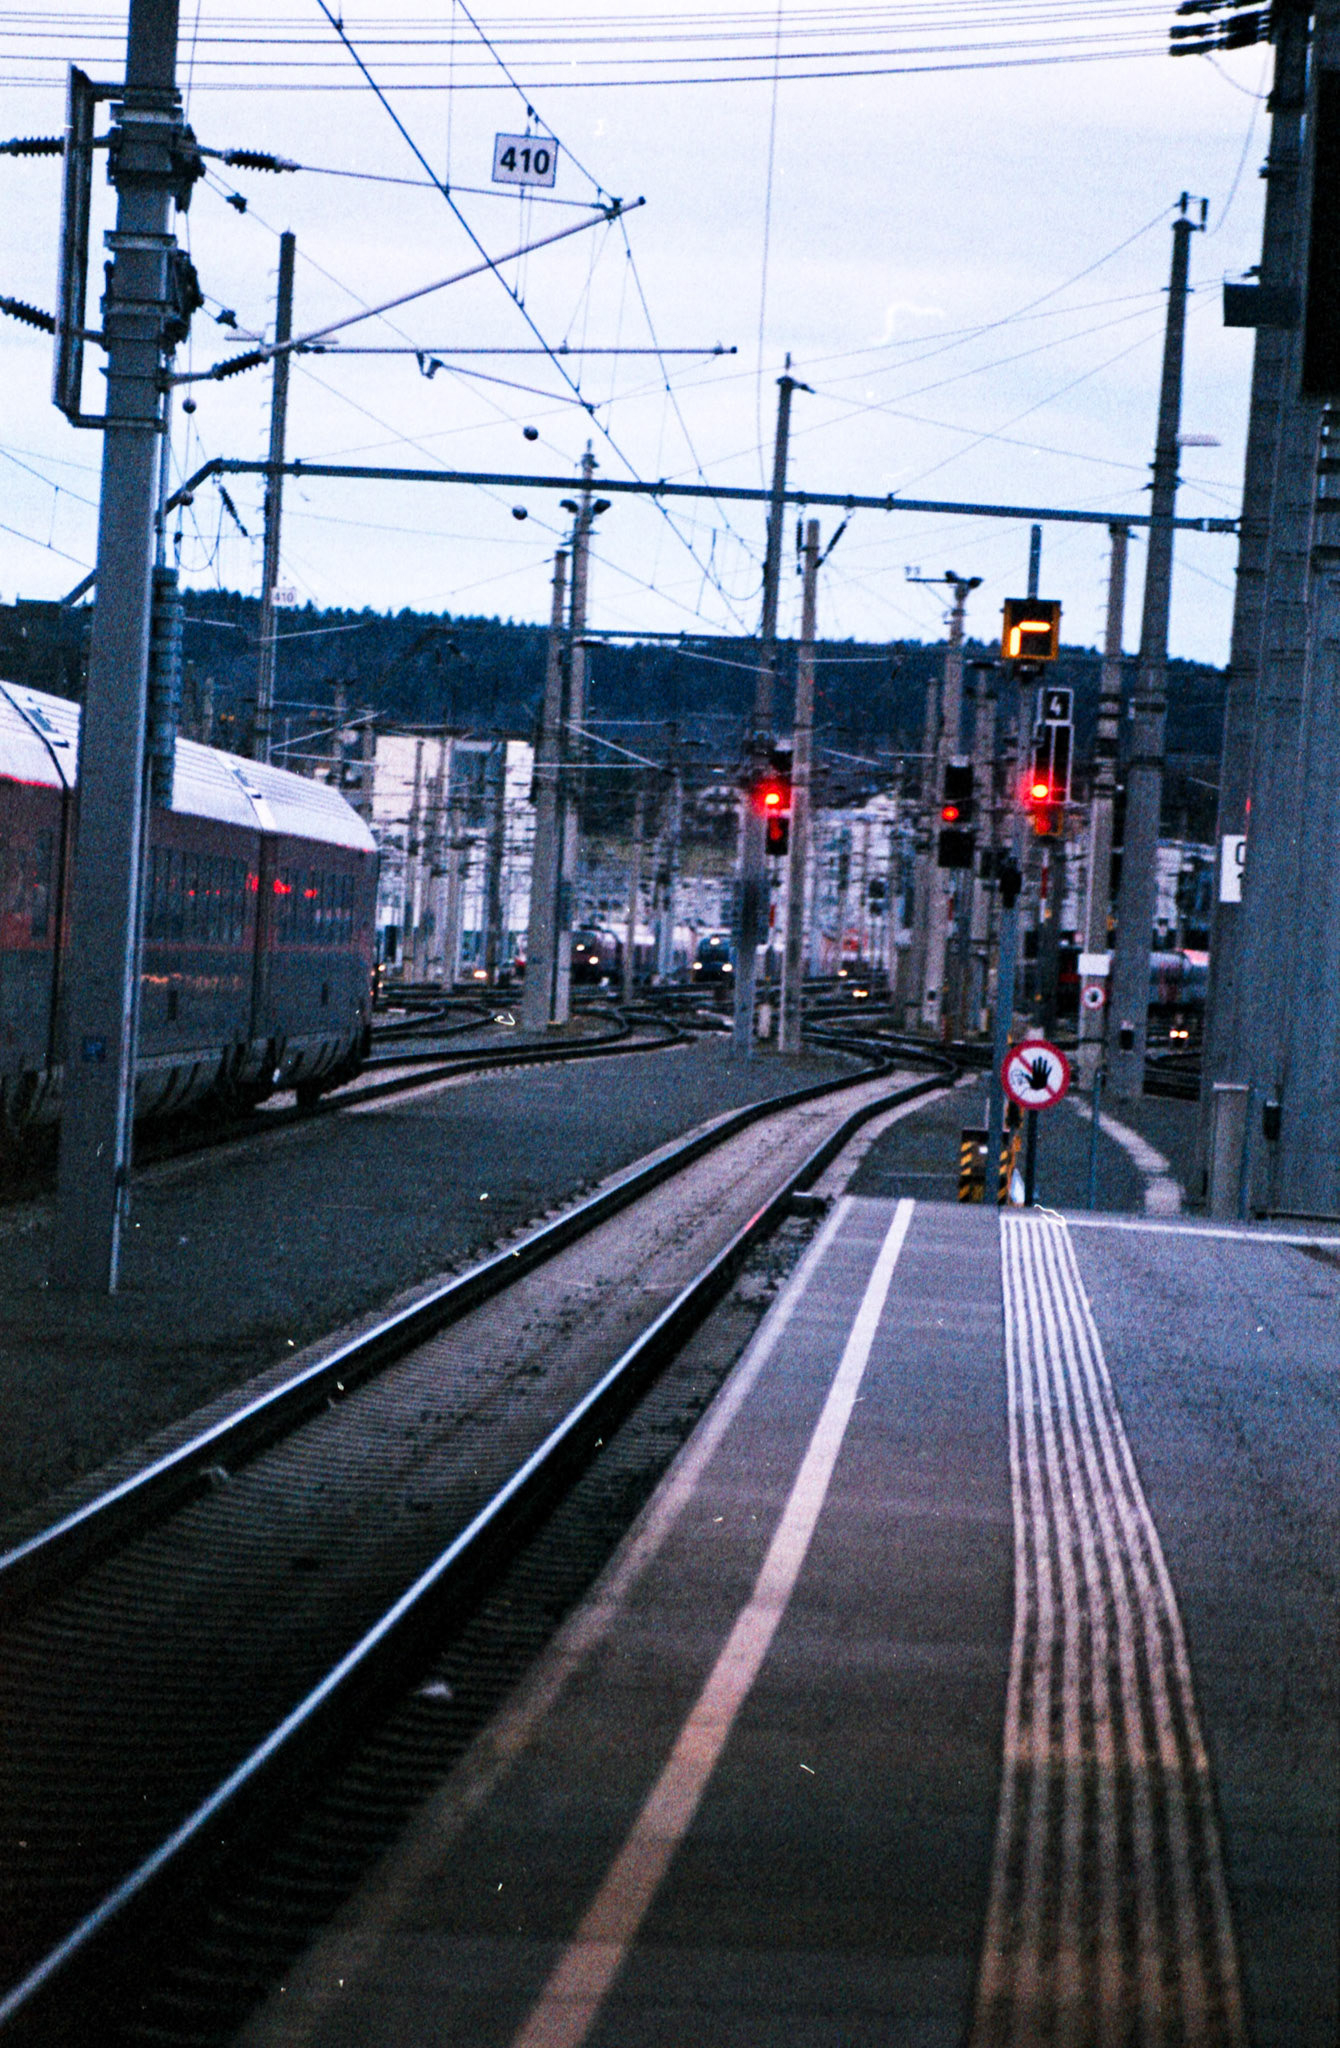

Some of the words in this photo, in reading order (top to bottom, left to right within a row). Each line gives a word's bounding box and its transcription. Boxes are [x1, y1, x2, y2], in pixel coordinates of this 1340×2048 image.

[500, 146, 550, 175] 410
[275, 592, 294, 603] 410
[1050, 695, 1061, 716] 4
